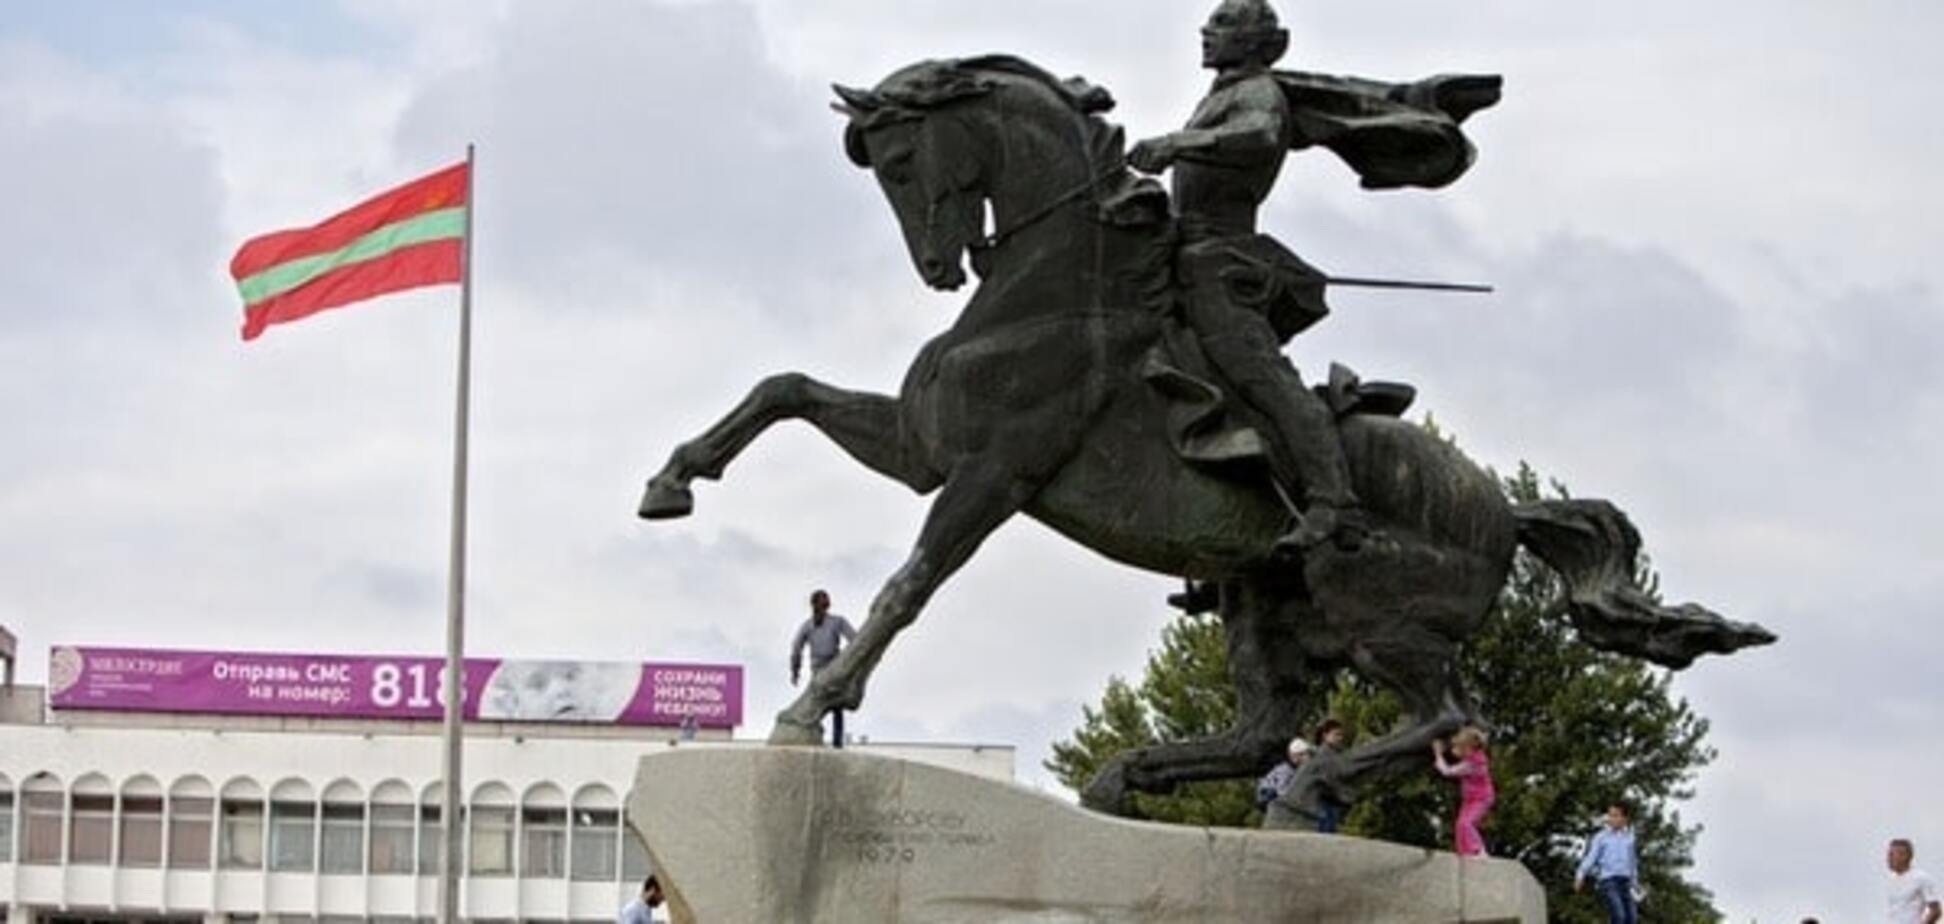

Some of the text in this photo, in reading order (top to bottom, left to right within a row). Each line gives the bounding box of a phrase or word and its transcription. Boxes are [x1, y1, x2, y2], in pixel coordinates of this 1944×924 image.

[213, 661, 351, 682] Отправь СМС
[654, 670, 727, 686] СОХРАНИ
[248, 686, 351, 704] на номер:
[654, 686, 723, 701] ЖИЗНЬ
